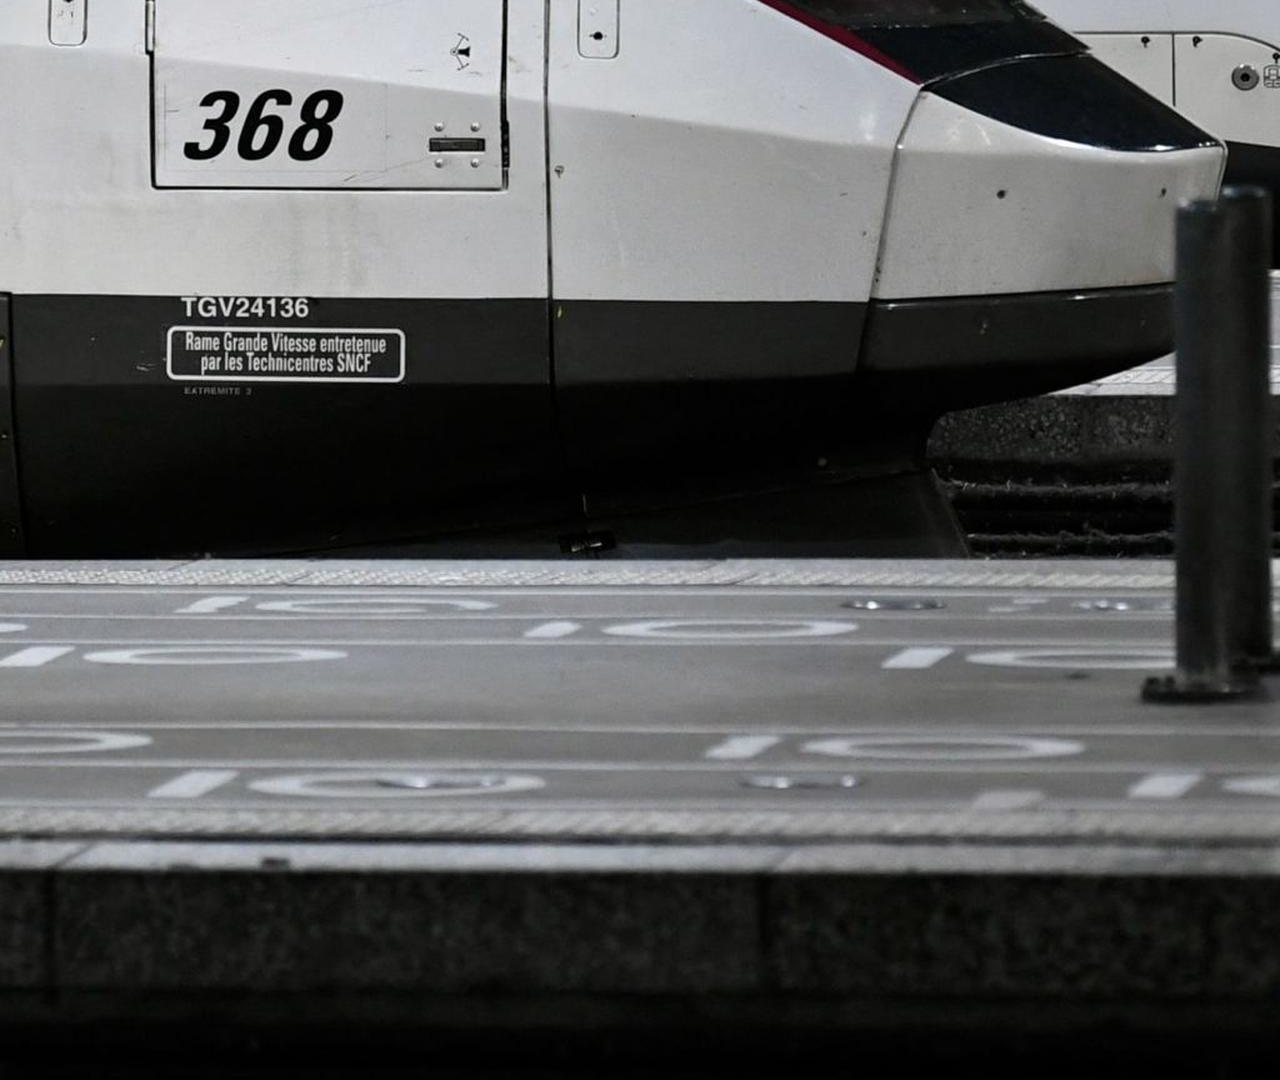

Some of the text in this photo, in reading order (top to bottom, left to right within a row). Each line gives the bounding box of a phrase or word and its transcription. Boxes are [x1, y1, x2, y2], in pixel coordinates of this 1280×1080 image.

[182, 88, 345, 162] 368
[180, 296, 310, 318] TGV24136
[185, 331, 387, 354] Rame Grande Vitesse entretenue
[201, 352, 372, 375] par les Technicentres SNCF
